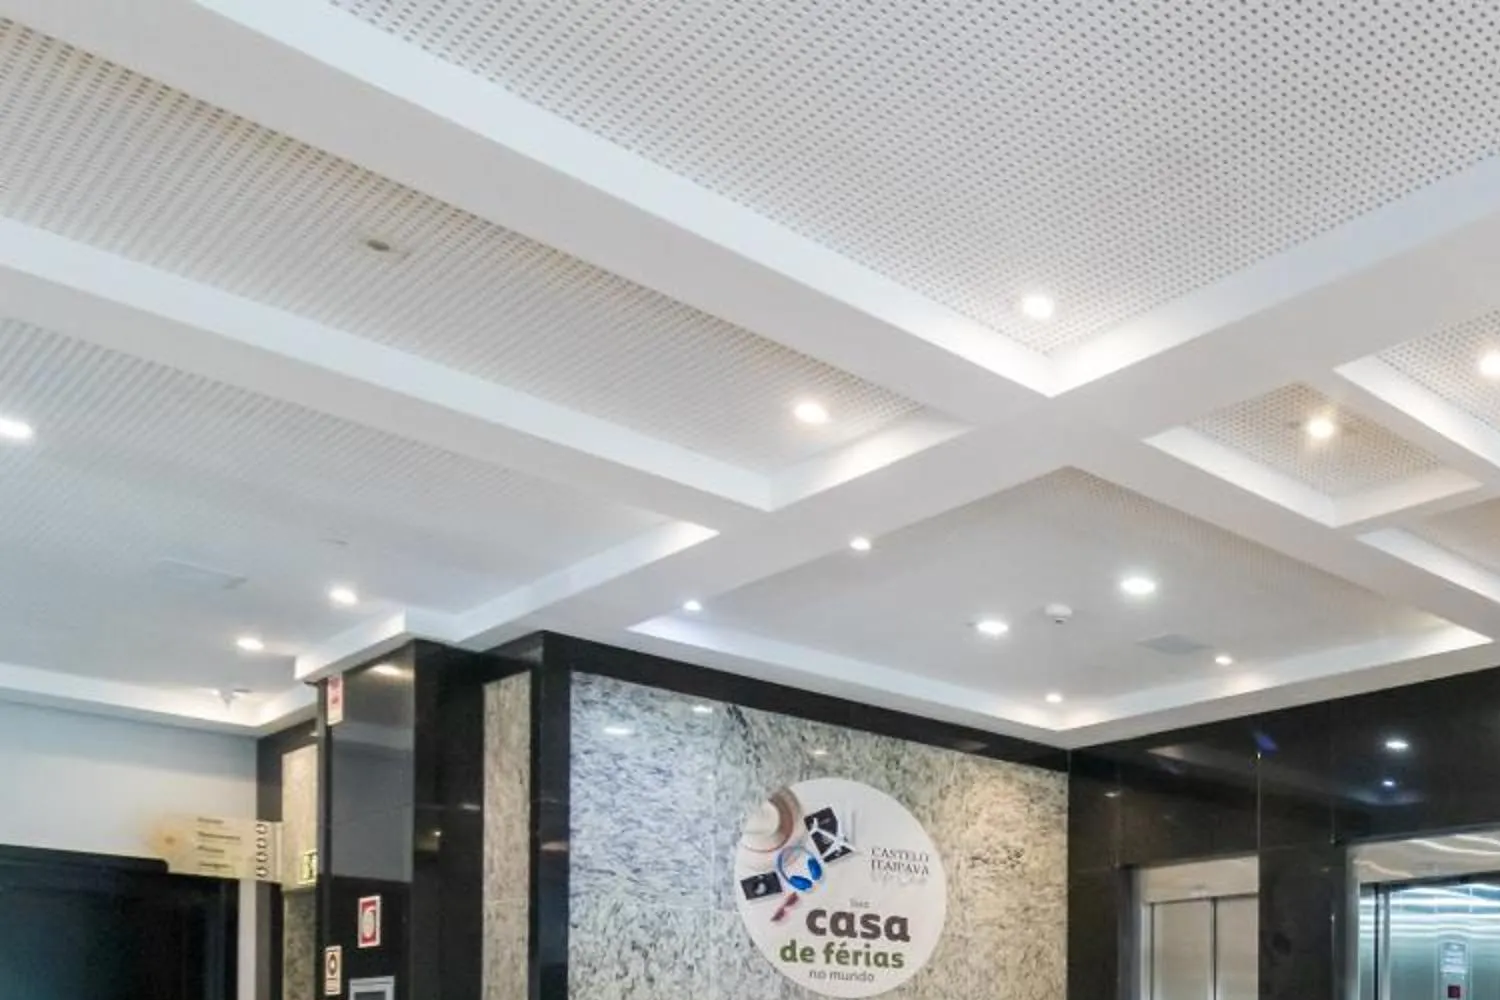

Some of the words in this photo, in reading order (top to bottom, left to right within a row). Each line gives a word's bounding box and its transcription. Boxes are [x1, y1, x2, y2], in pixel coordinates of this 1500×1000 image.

[871, 847, 929, 862] CASTELO
[871, 859, 929, 875] ITAIPAVA
[805, 908, 911, 942] casa
[780, 939, 815, 963] de
[823, 941, 905, 968] férias
[809, 970, 826, 979] no
[829, 970, 875, 983] mundo
